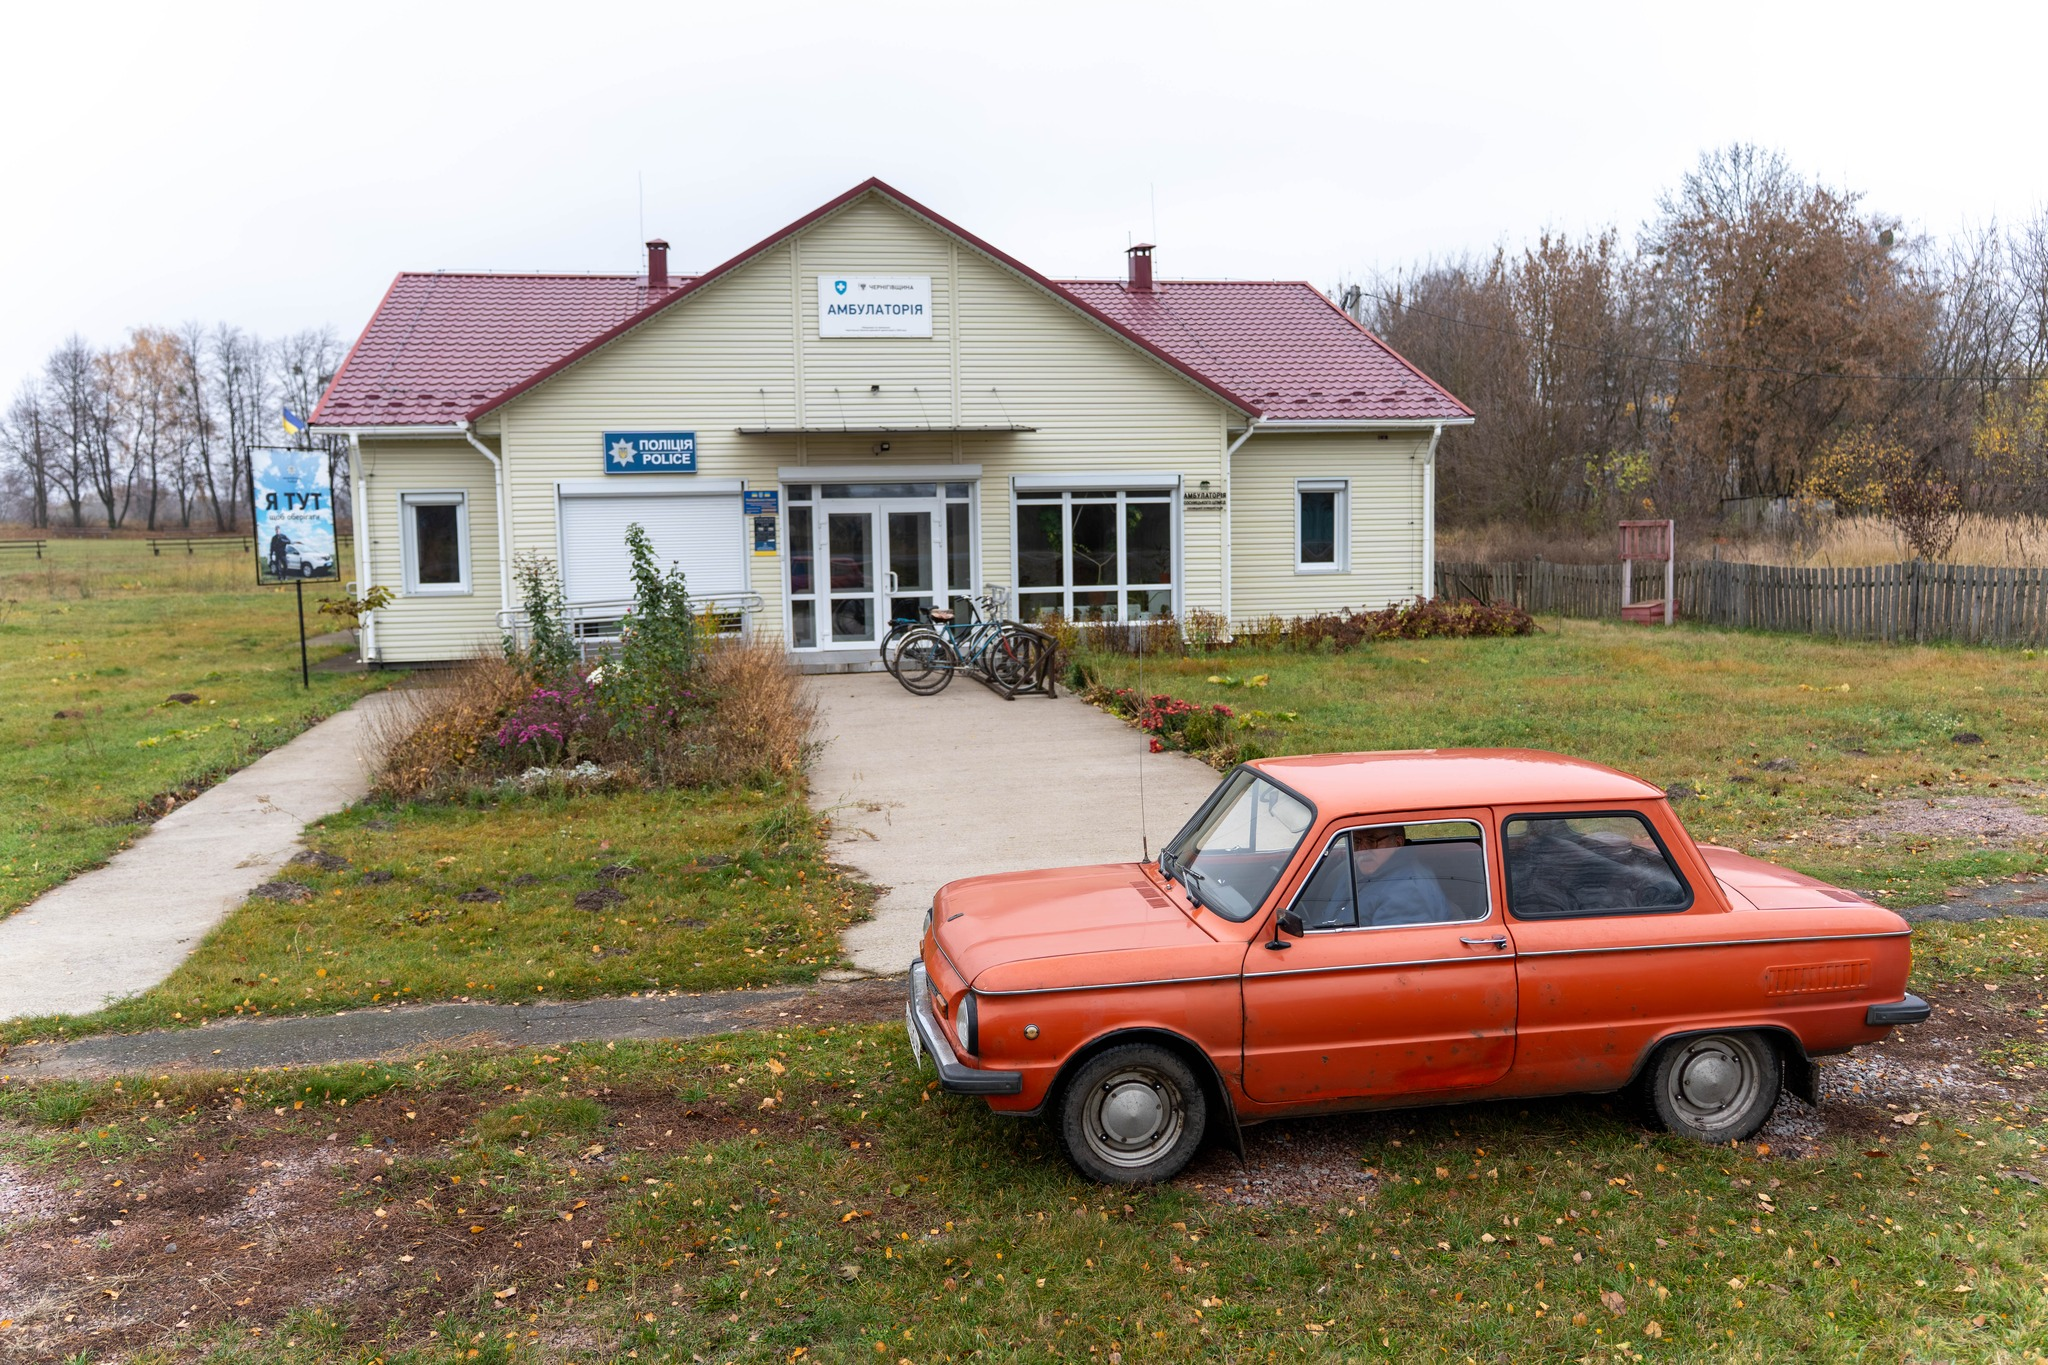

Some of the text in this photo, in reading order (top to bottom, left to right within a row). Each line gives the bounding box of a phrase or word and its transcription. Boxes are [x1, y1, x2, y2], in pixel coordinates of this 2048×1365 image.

[827, 304, 923, 315] АМБУЛАТОРІЯ
[639, 439, 693, 452] ПОЛІЦІЯ
[643, 453, 691, 465] POLICE
[266, 492, 322, 510] Я ТУТ
[269, 513, 320, 522] щоб оберігати
